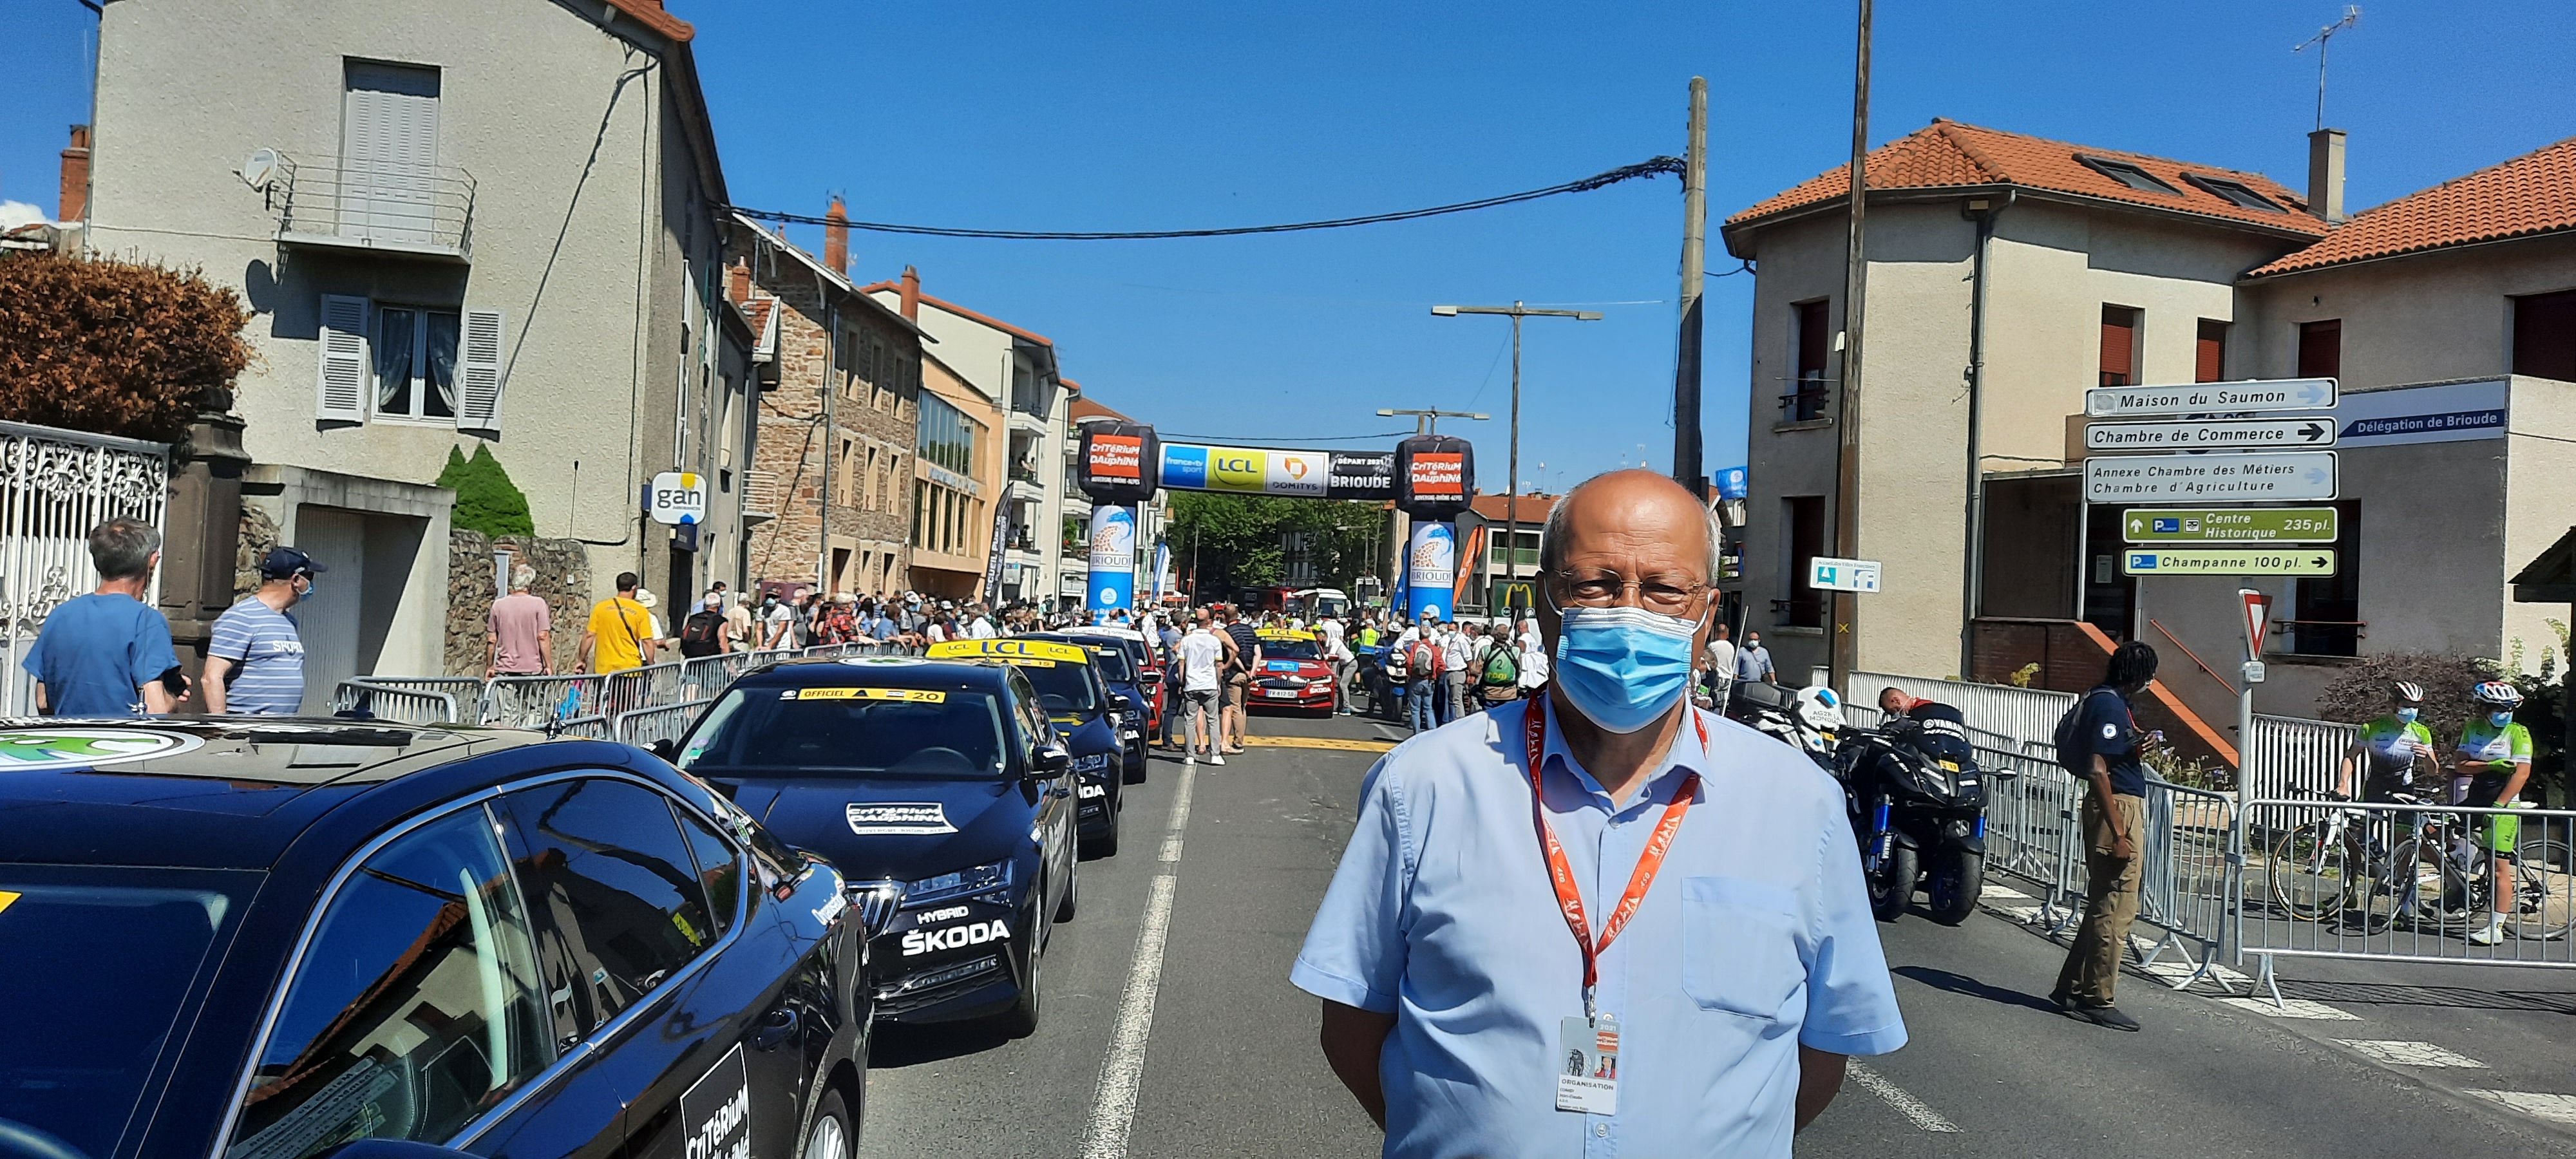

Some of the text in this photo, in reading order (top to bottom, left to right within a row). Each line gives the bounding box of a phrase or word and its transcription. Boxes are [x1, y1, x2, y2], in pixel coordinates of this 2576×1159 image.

[2119, 391, 2286, 408] Maison du Saumon
[2358, 412, 2497, 433] Délégation de Brioude
[2094, 426, 2284, 443] Chambre de Commerce
[1218, 458, 1258, 473] LCL
[1338, 457, 1366, 466] DÉPART
[2093, 464, 2295, 478] Annexe Chambre des Métiers
[1273, 481, 1318, 491] DOMITYS
[1331, 475, 1392, 489] BRIOUDE
[2094, 480, 2275, 495] Chambre d'Agriculture
[657, 489, 701, 509] gan
[2205, 513, 2251, 524] Centre
[2283, 518, 2331, 532] 235 pl.
[2204, 527, 2277, 540] Historique
[2162, 556, 2302, 570] Champanne 100 pl.
[985, 553, 998, 598] ACCUEIL
[981, 641, 1035, 655] LCL
[1049, 646, 1072, 655] LCL
[1496, 659, 1503, 670] 2
[916, 905, 969, 925] HYBRID
[902, 919, 1011, 956] ŠKODA
[1599, 1023, 1616, 1032] 2021
[1561, 1079, 1614, 1090] ORGANISATION
